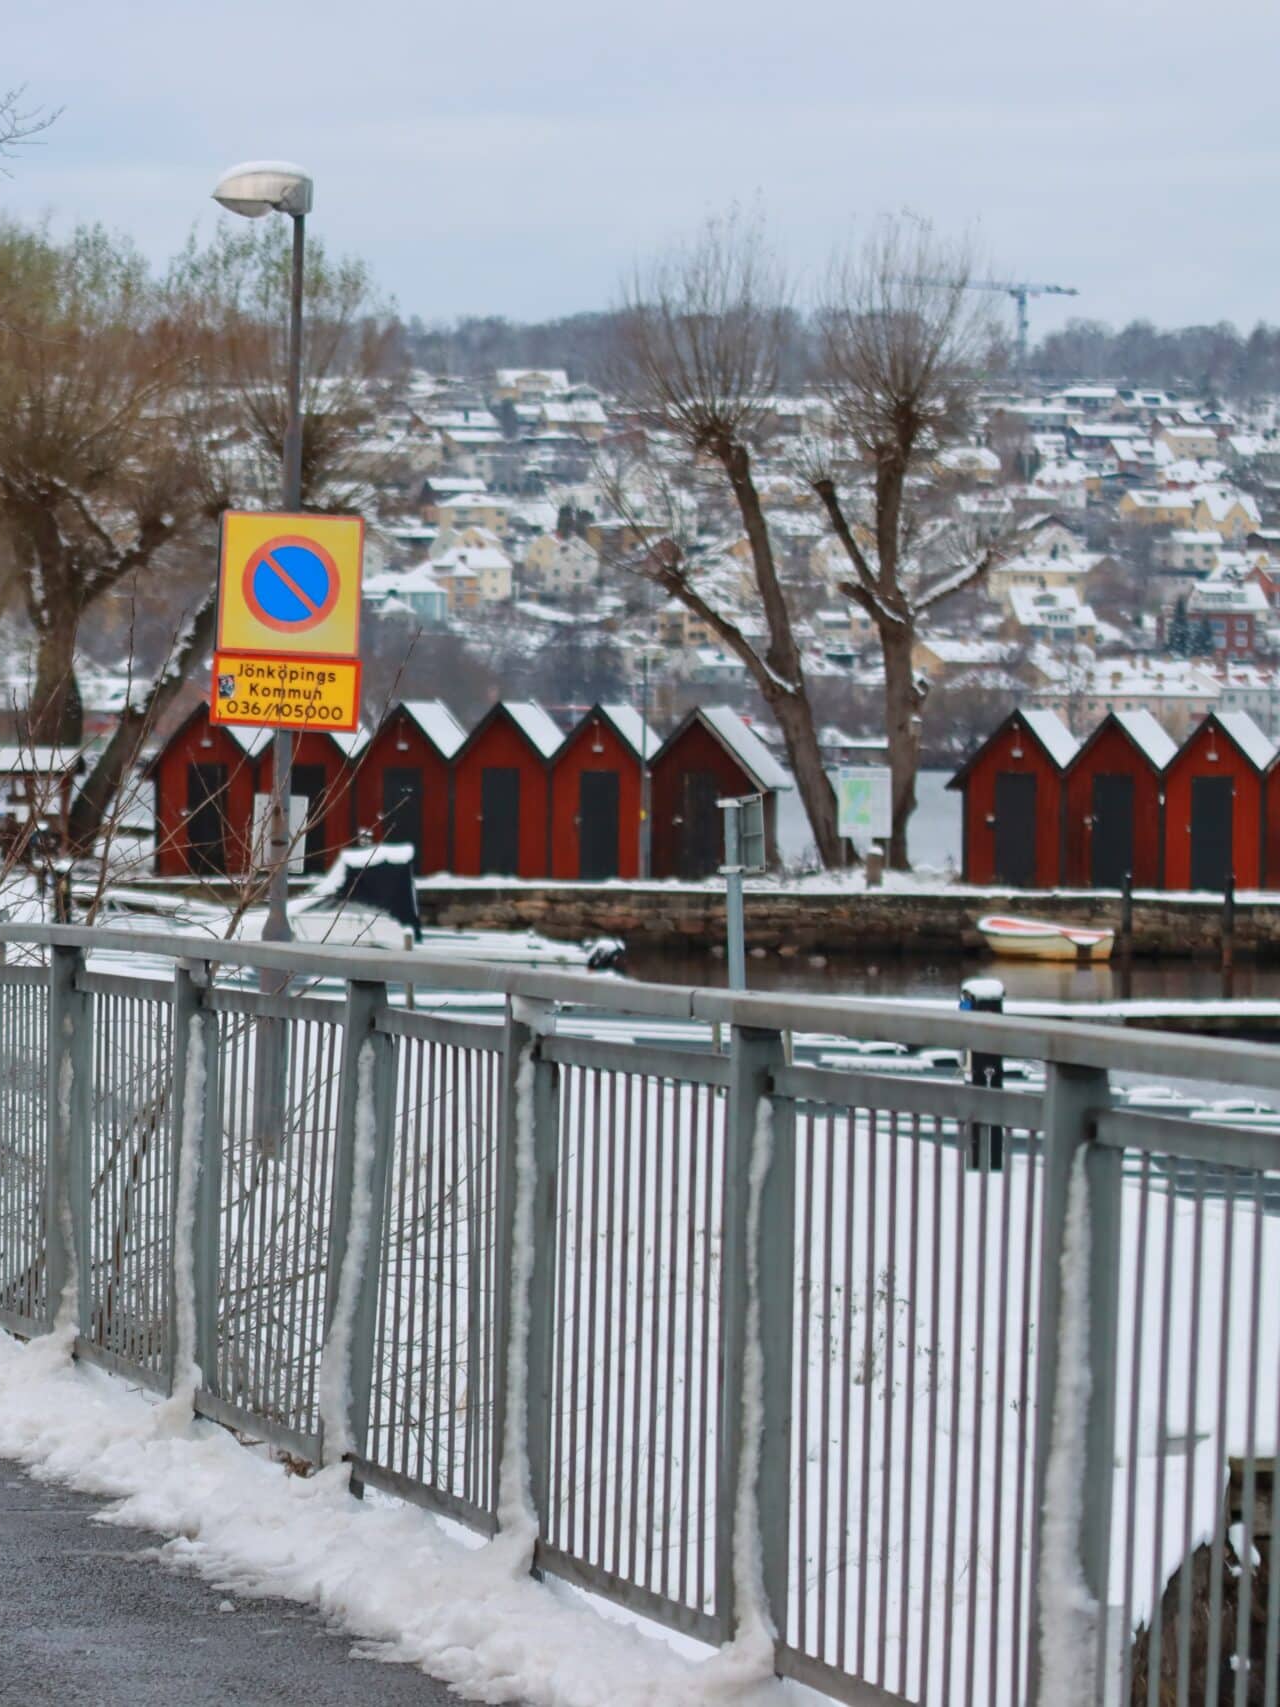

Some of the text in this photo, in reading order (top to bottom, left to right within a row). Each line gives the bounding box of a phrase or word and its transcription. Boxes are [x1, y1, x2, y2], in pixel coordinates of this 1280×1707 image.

[237, 664, 336, 685] Jönköpings
[249, 683, 322, 700] Kommun
[226, 700, 343, 721] 036/105000
